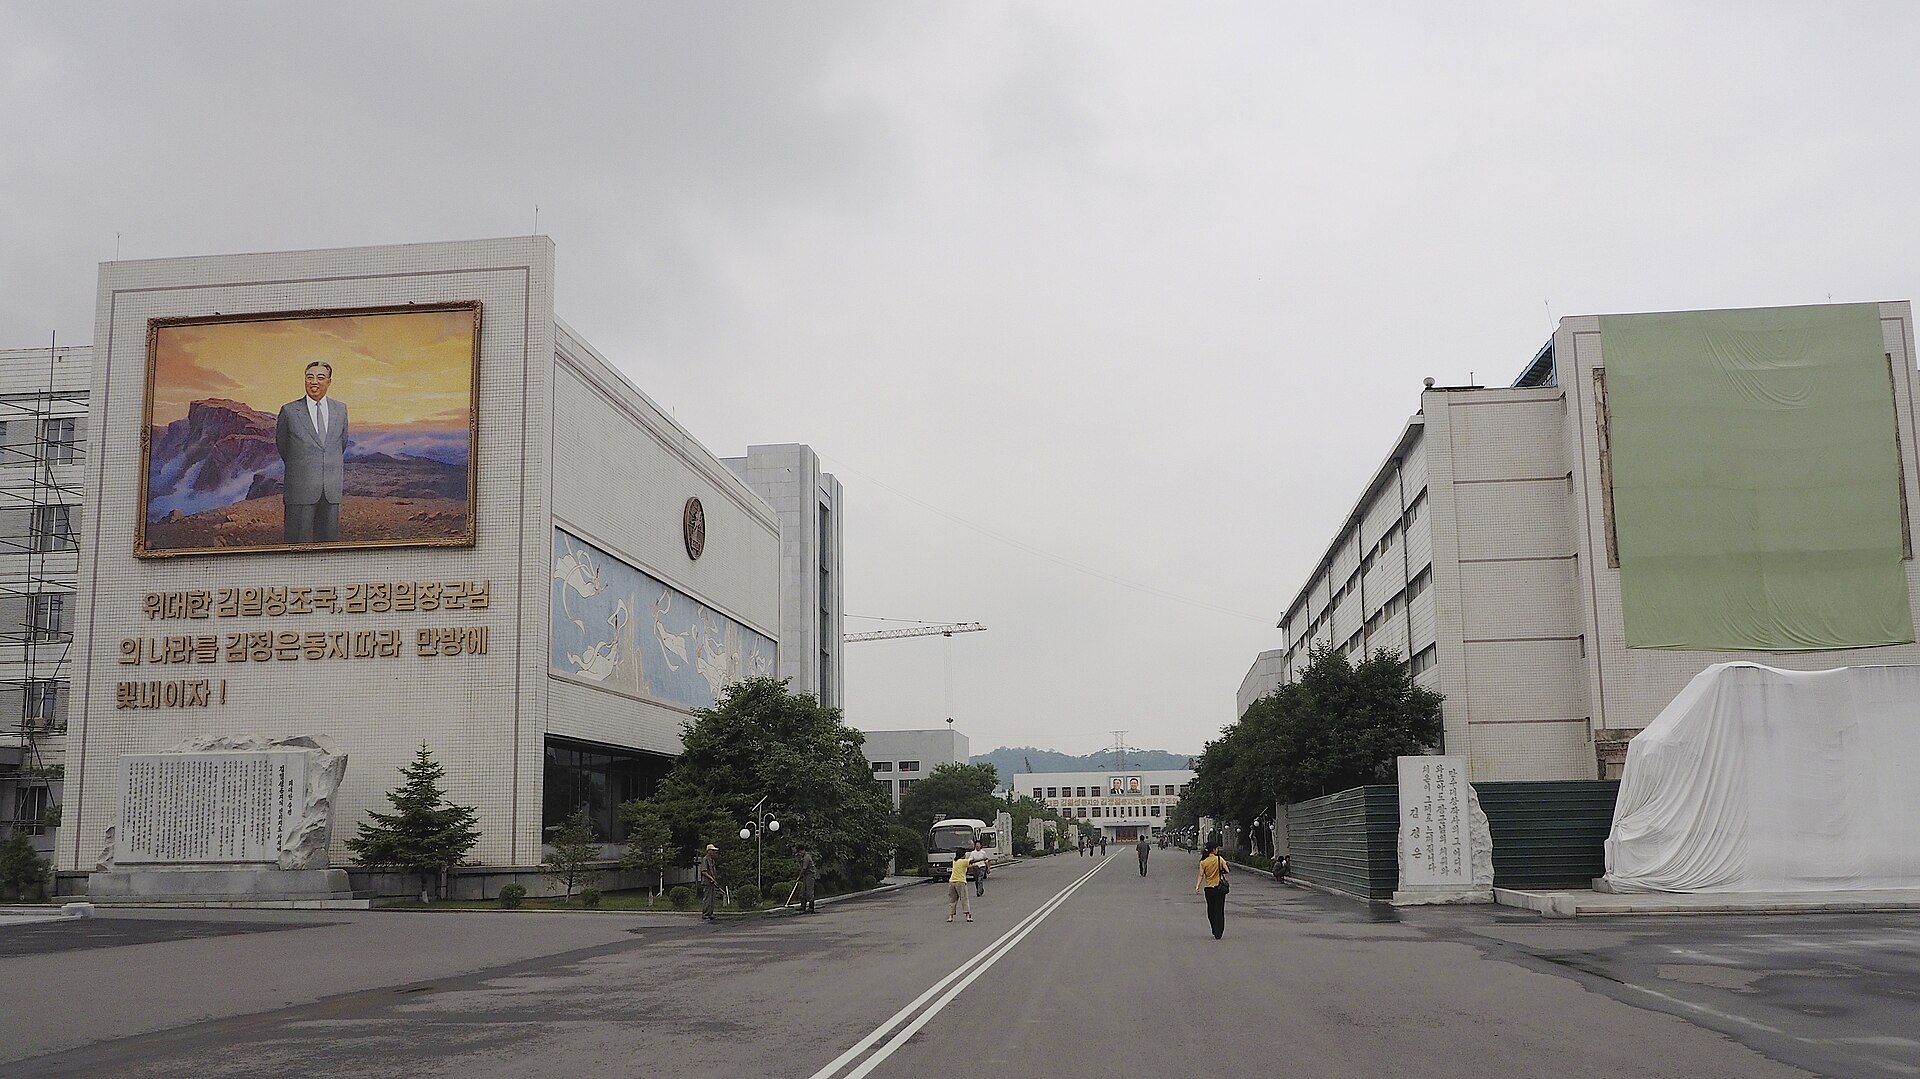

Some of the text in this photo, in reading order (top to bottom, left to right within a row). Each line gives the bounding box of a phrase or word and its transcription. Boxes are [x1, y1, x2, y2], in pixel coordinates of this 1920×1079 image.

[144, 589, 213, 620] 위대한
[119, 637, 141, 665] 의
[148, 634, 219, 664] 나라를
[416, 625, 489, 656] 만방에
